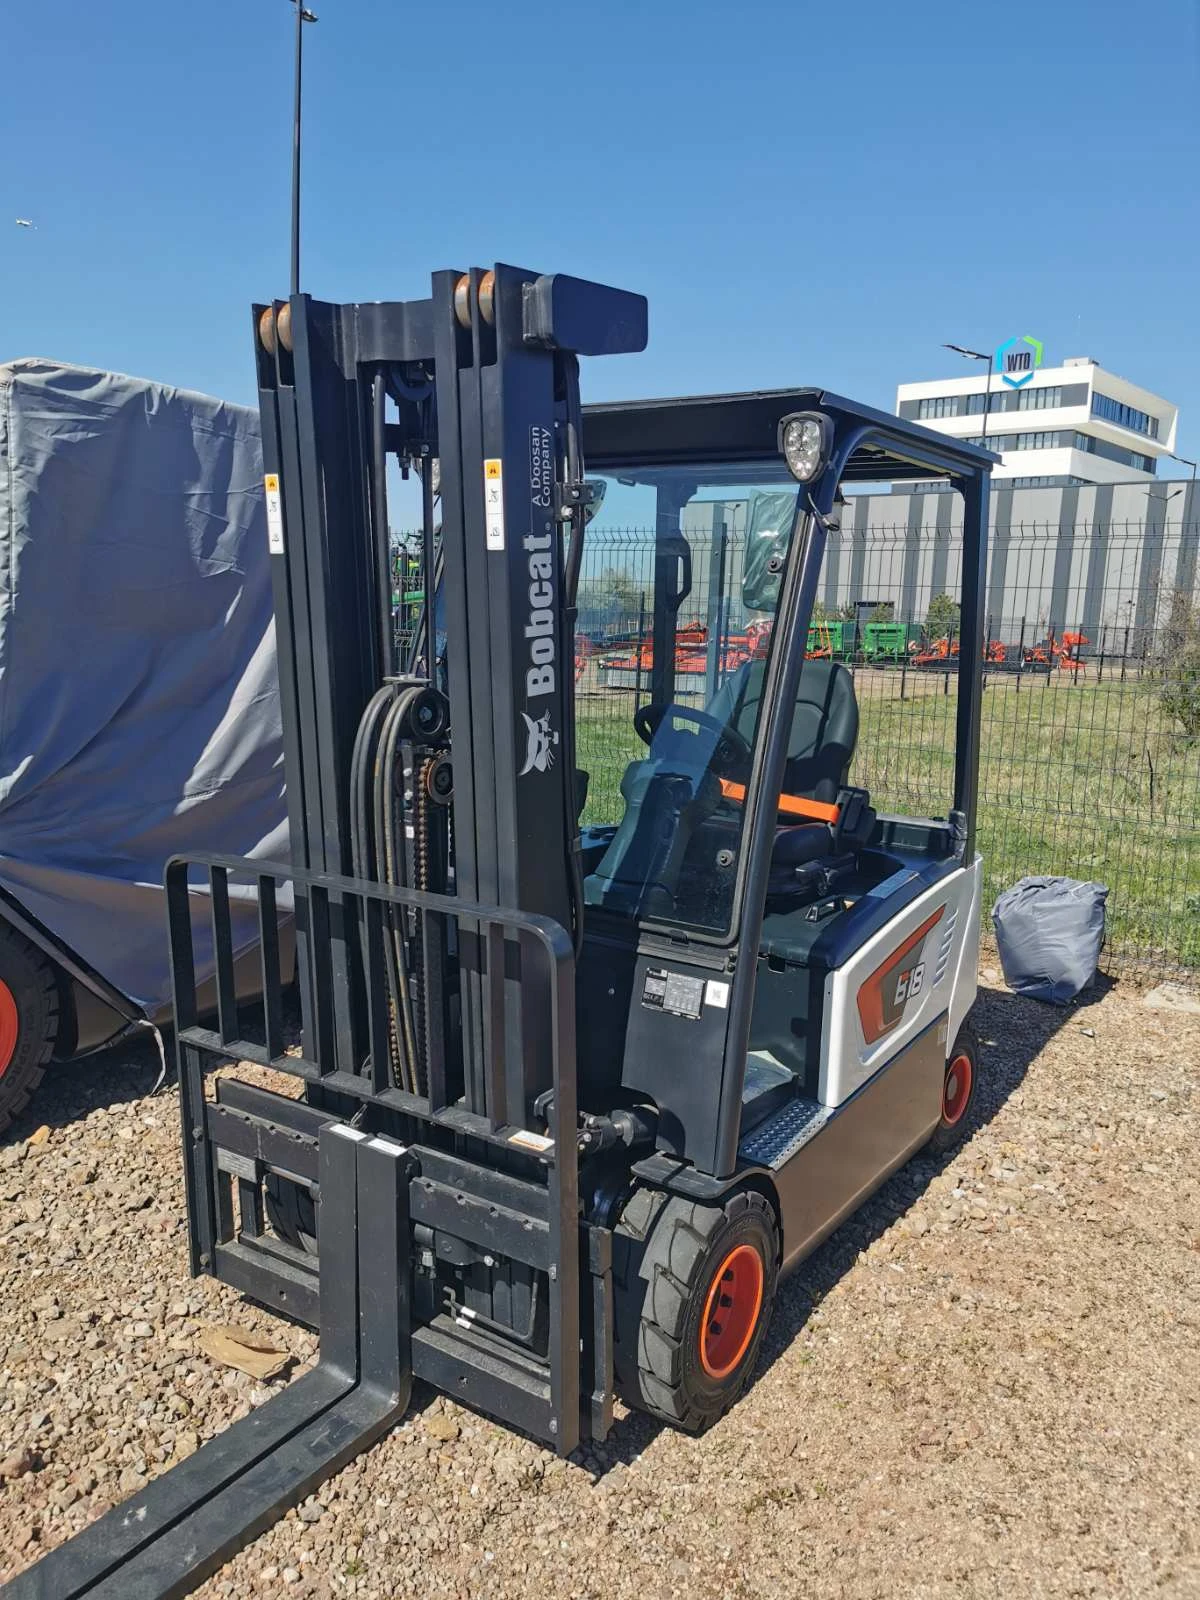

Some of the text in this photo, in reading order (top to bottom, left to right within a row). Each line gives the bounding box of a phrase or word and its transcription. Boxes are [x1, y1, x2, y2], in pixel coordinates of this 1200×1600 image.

[1007, 352, 1031, 372] WTO
[531, 426, 541, 507] A Doosan
[541, 427, 552, 507] Company
[522, 533, 555, 697] Bobcat
